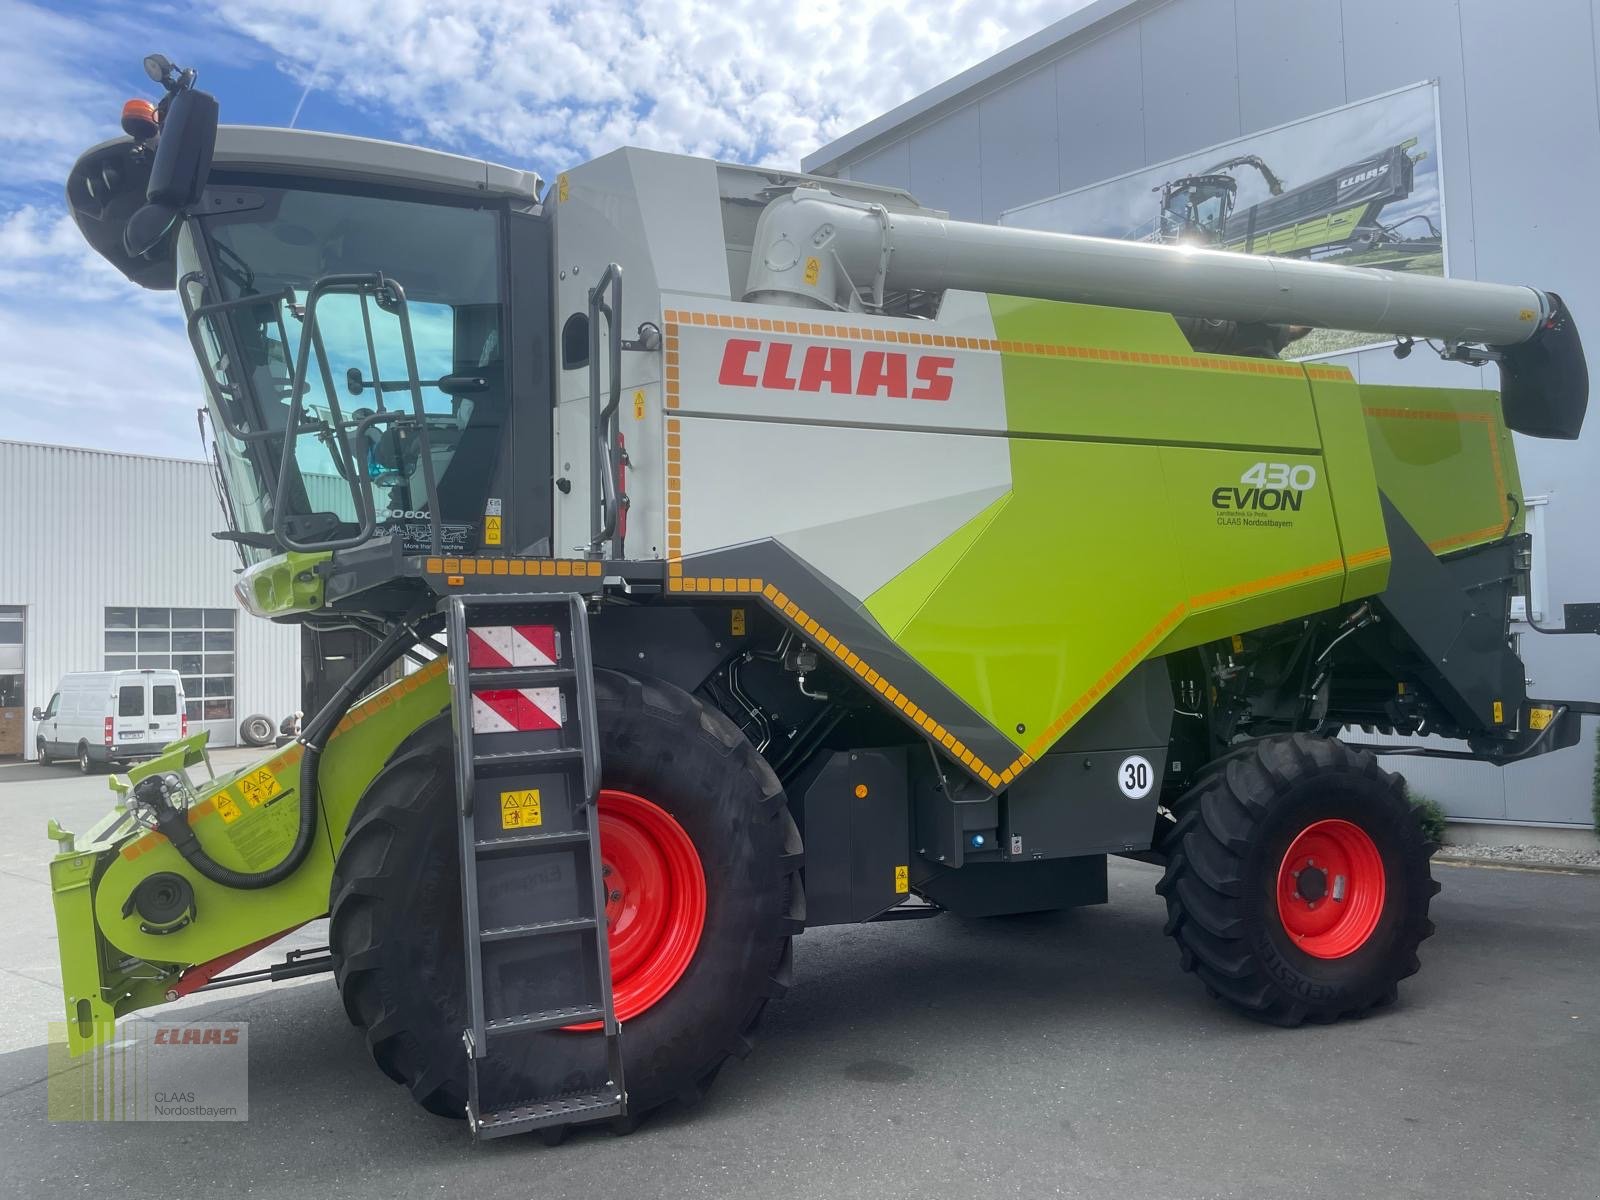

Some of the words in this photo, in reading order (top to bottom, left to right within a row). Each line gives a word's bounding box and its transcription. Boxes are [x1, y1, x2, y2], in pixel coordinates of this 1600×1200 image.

[1340, 164, 1390, 189] CLAAS
[718, 338, 956, 402] CLAAS
[1240, 462, 1316, 491] 430
[1211, 487, 1303, 511] EVION
[1216, 517, 1242, 526] CLAAS
[1243, 518, 1293, 529] Nordostbayern
[1125, 763, 1147, 790] 30
